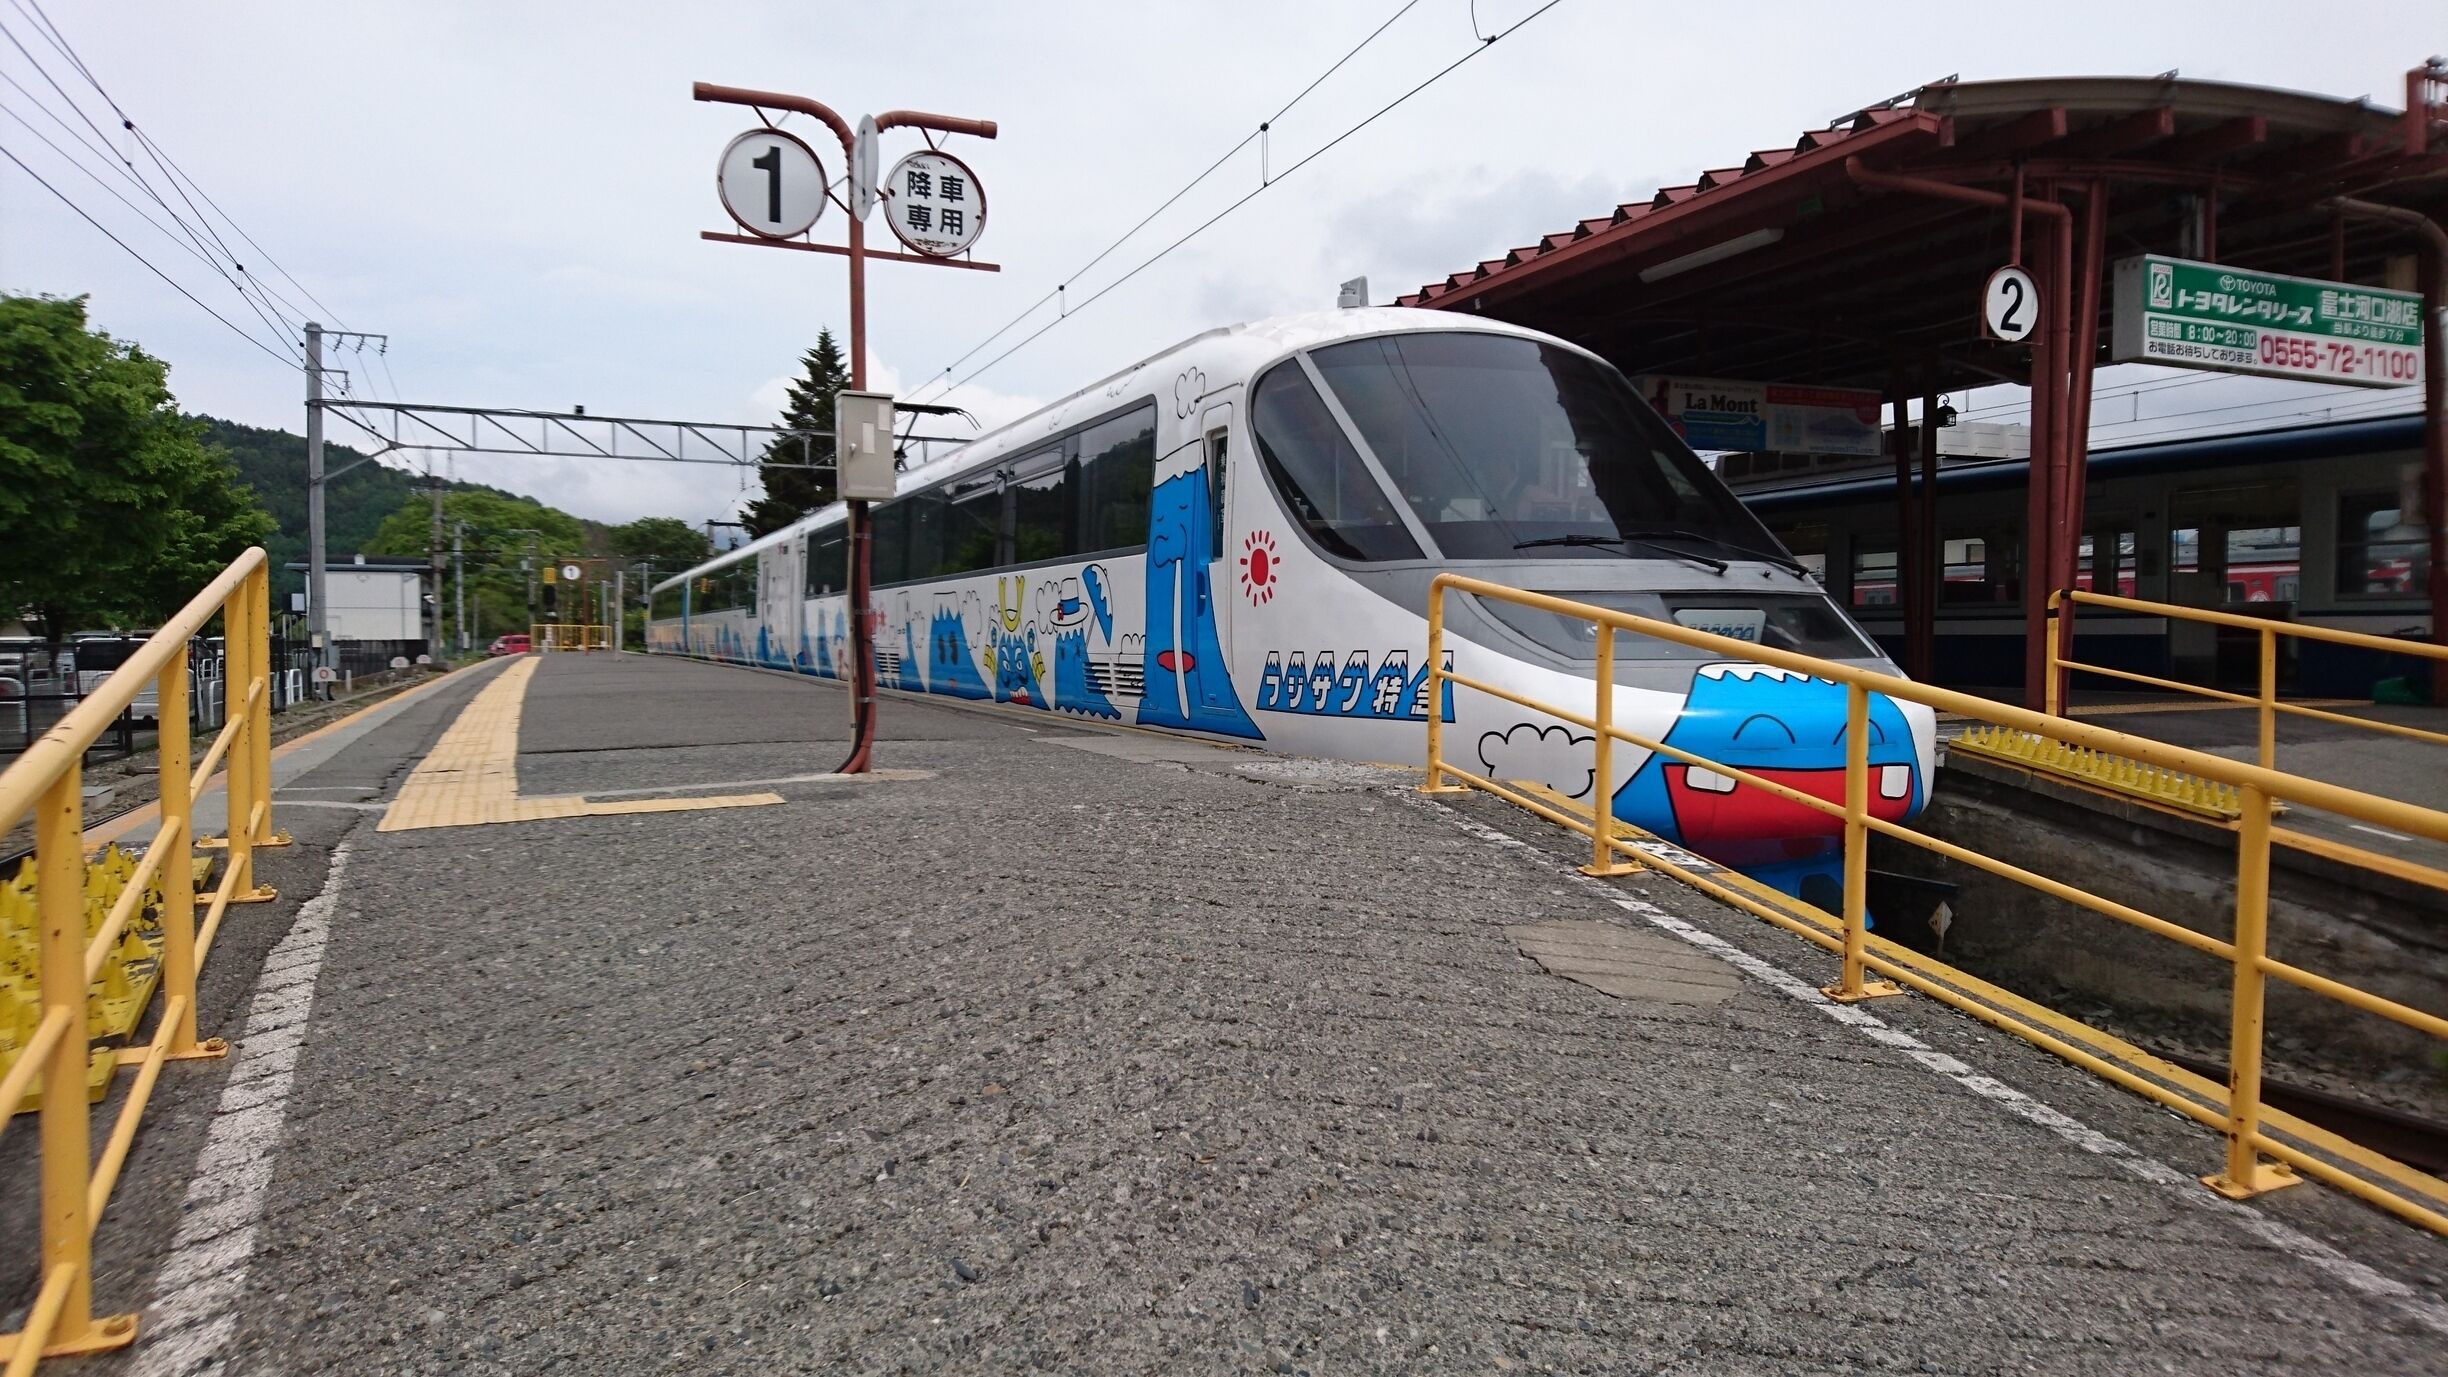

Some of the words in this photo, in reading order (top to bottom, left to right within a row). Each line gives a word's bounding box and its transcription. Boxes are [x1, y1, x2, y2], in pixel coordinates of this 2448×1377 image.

[753, 146, 781, 223] 1
[907, 171, 964, 203] 降車
[907, 204, 963, 236] 専用
[2237, 279, 2276, 296] TOYOTA
[2000, 277, 2023, 332] 2
[2177, 289, 2314, 325] トヨタレンタリース
[2322, 290, 2418, 326] 富士河口湖店
[2150, 320, 2181, 339] 営業時間
[2149, 342, 2257, 364] お電話お待ちしております。
[2261, 334, 2417, 380] 0555-72-1100
[1685, 393, 1707, 410] La
[1710, 394, 1758, 412] Mont
